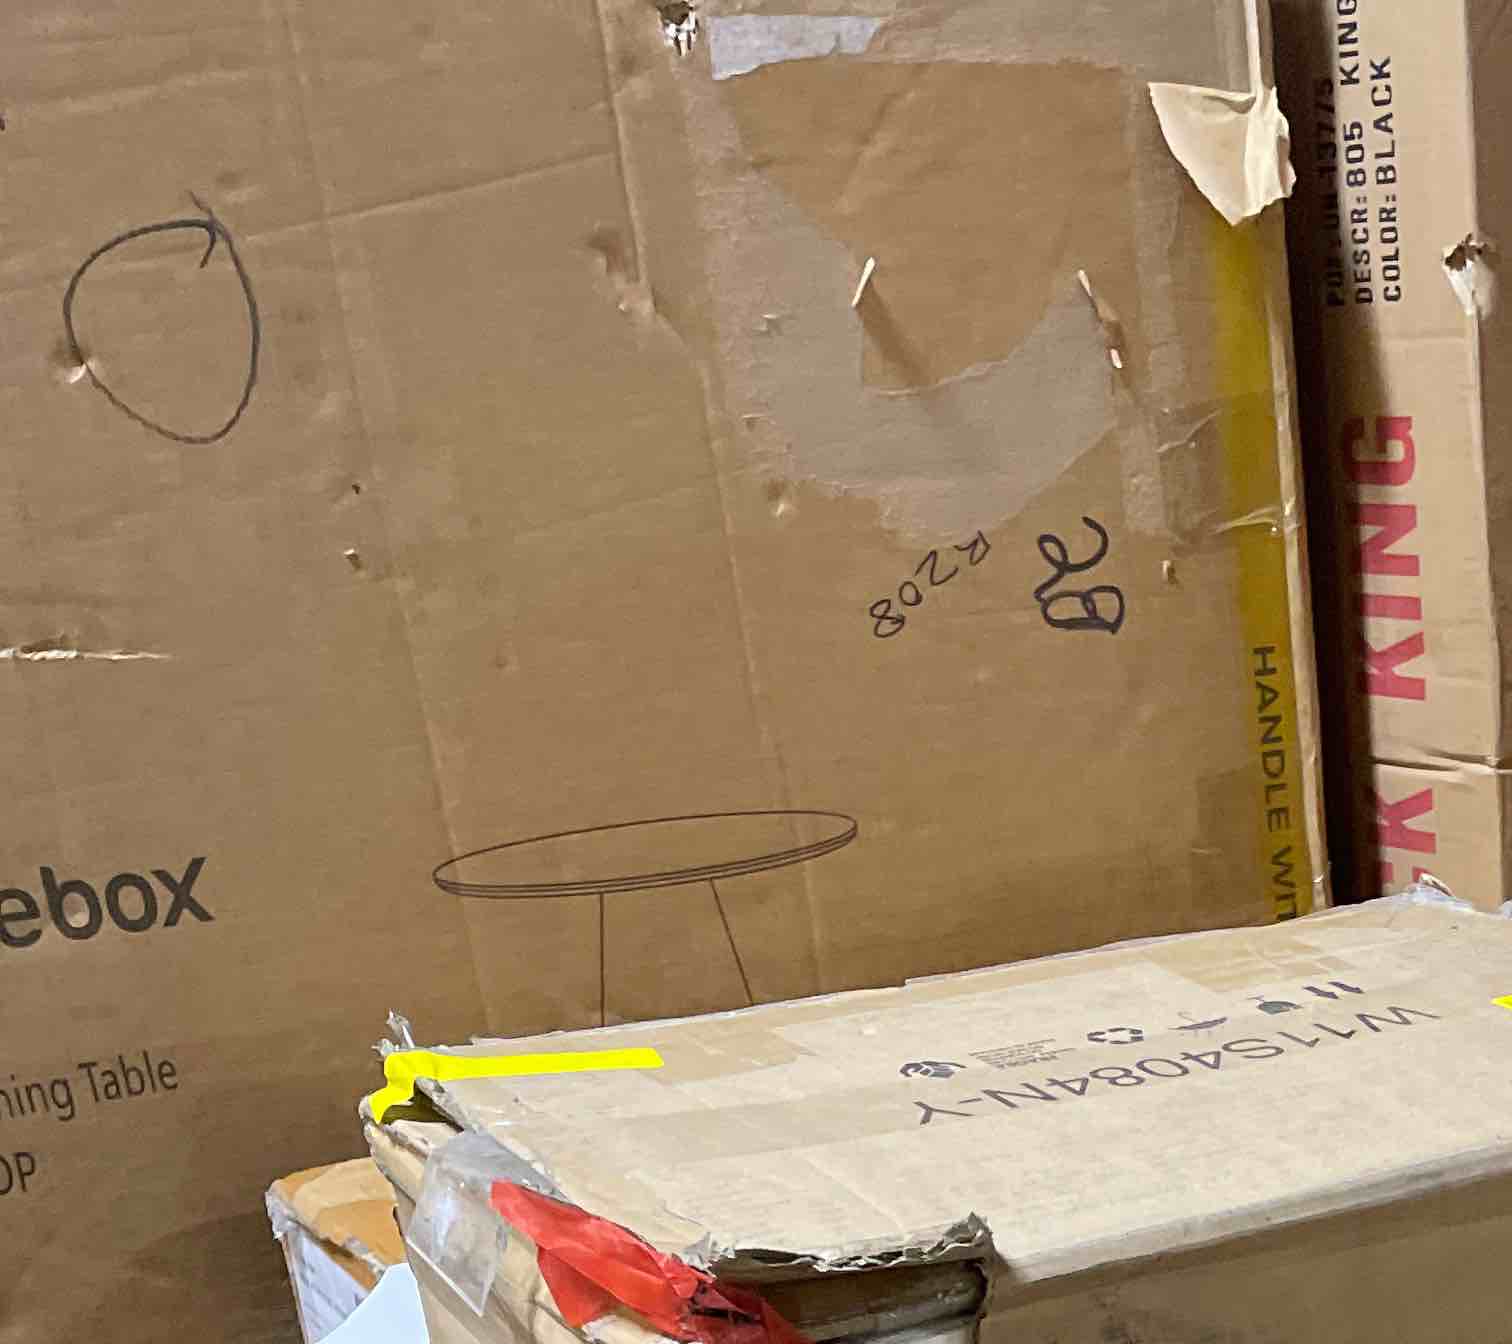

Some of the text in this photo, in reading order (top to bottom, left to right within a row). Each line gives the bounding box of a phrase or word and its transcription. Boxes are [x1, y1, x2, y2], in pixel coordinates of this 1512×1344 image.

[1345, 415, 1426, 701] KING
[1253, 644, 1292, 834] HANDLE
[78, 1050, 179, 1104] Table
[911, 1004, 1442, 1126] W11S4084N-Y
